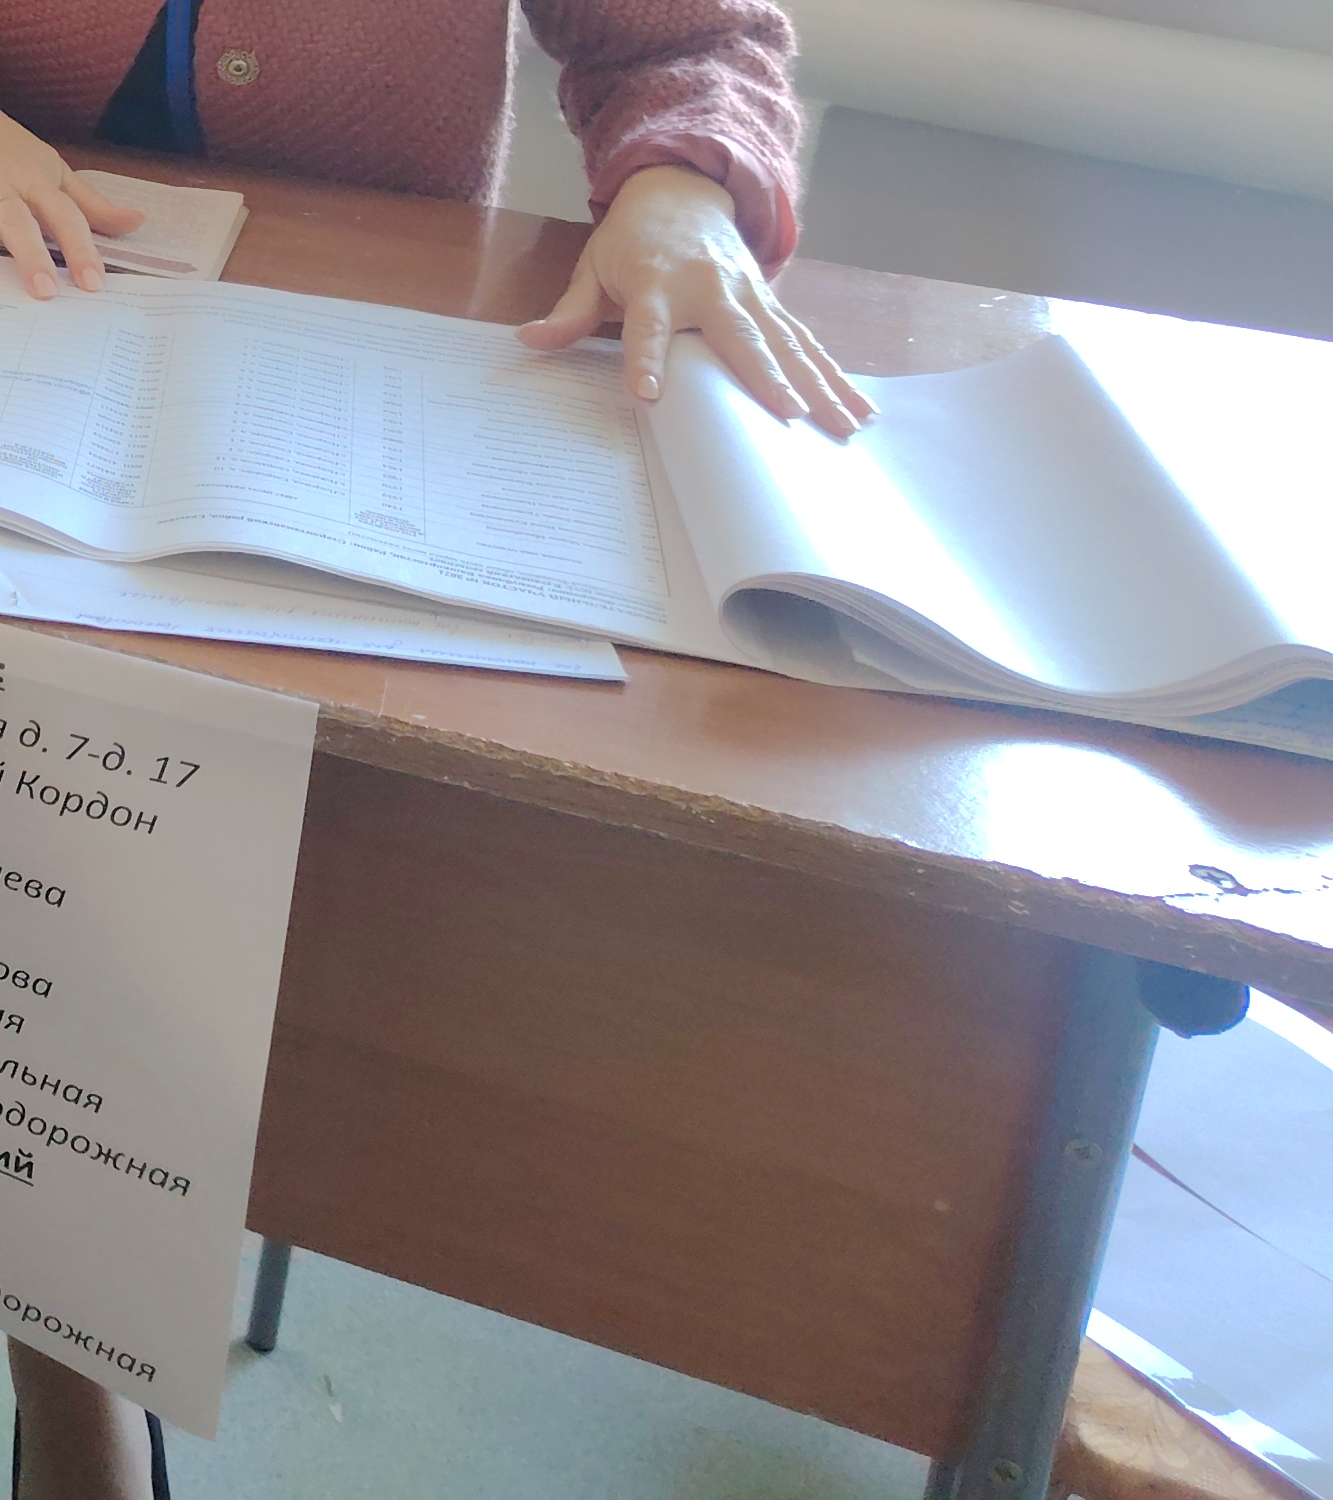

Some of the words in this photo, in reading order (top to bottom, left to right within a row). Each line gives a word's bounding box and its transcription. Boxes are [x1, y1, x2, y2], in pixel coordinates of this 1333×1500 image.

[19, 720, 47, 753] д.
[66, 734, 132, 775] 7-д.
[149, 757, 200, 787] 17
[16, 770, 158, 834] Кордон
